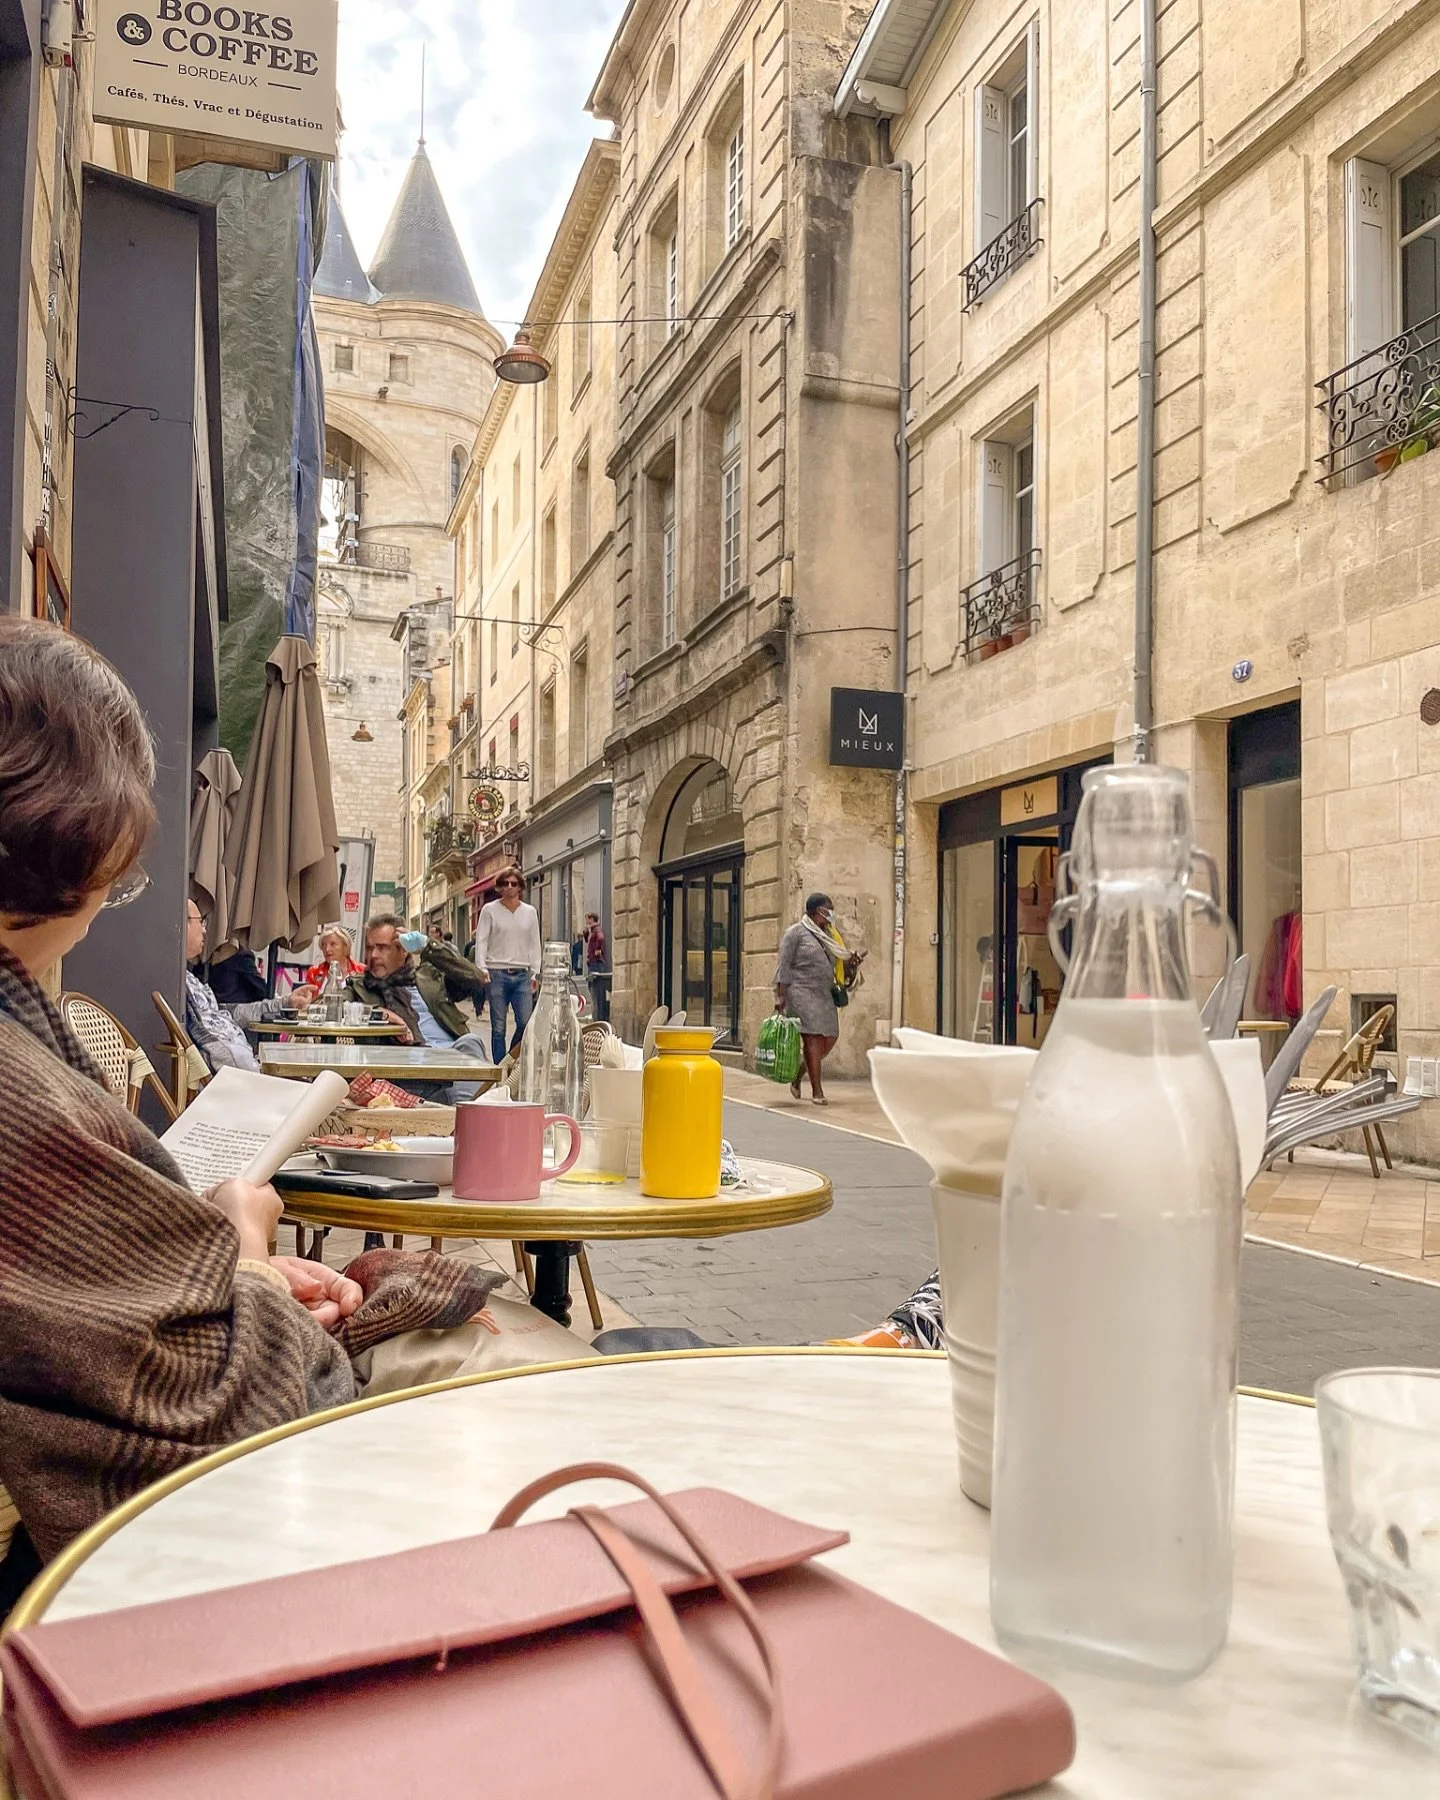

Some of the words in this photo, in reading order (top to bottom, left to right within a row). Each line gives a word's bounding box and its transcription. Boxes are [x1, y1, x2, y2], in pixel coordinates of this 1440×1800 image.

[157, 0, 293, 41] BOOKS
[123, 19, 145, 40] &
[162, 27, 319, 76] COFFEE
[178, 64, 258, 87] BORDEAUX
[107, 85, 147, 102] Cafés,
[152, 92, 189, 108] Thés,
[193, 99, 223, 113] Vrac
[228, 106, 241, 116] et
[245, 108, 323, 131] Dégustation
[840, 738, 894, 752] MIEUX
